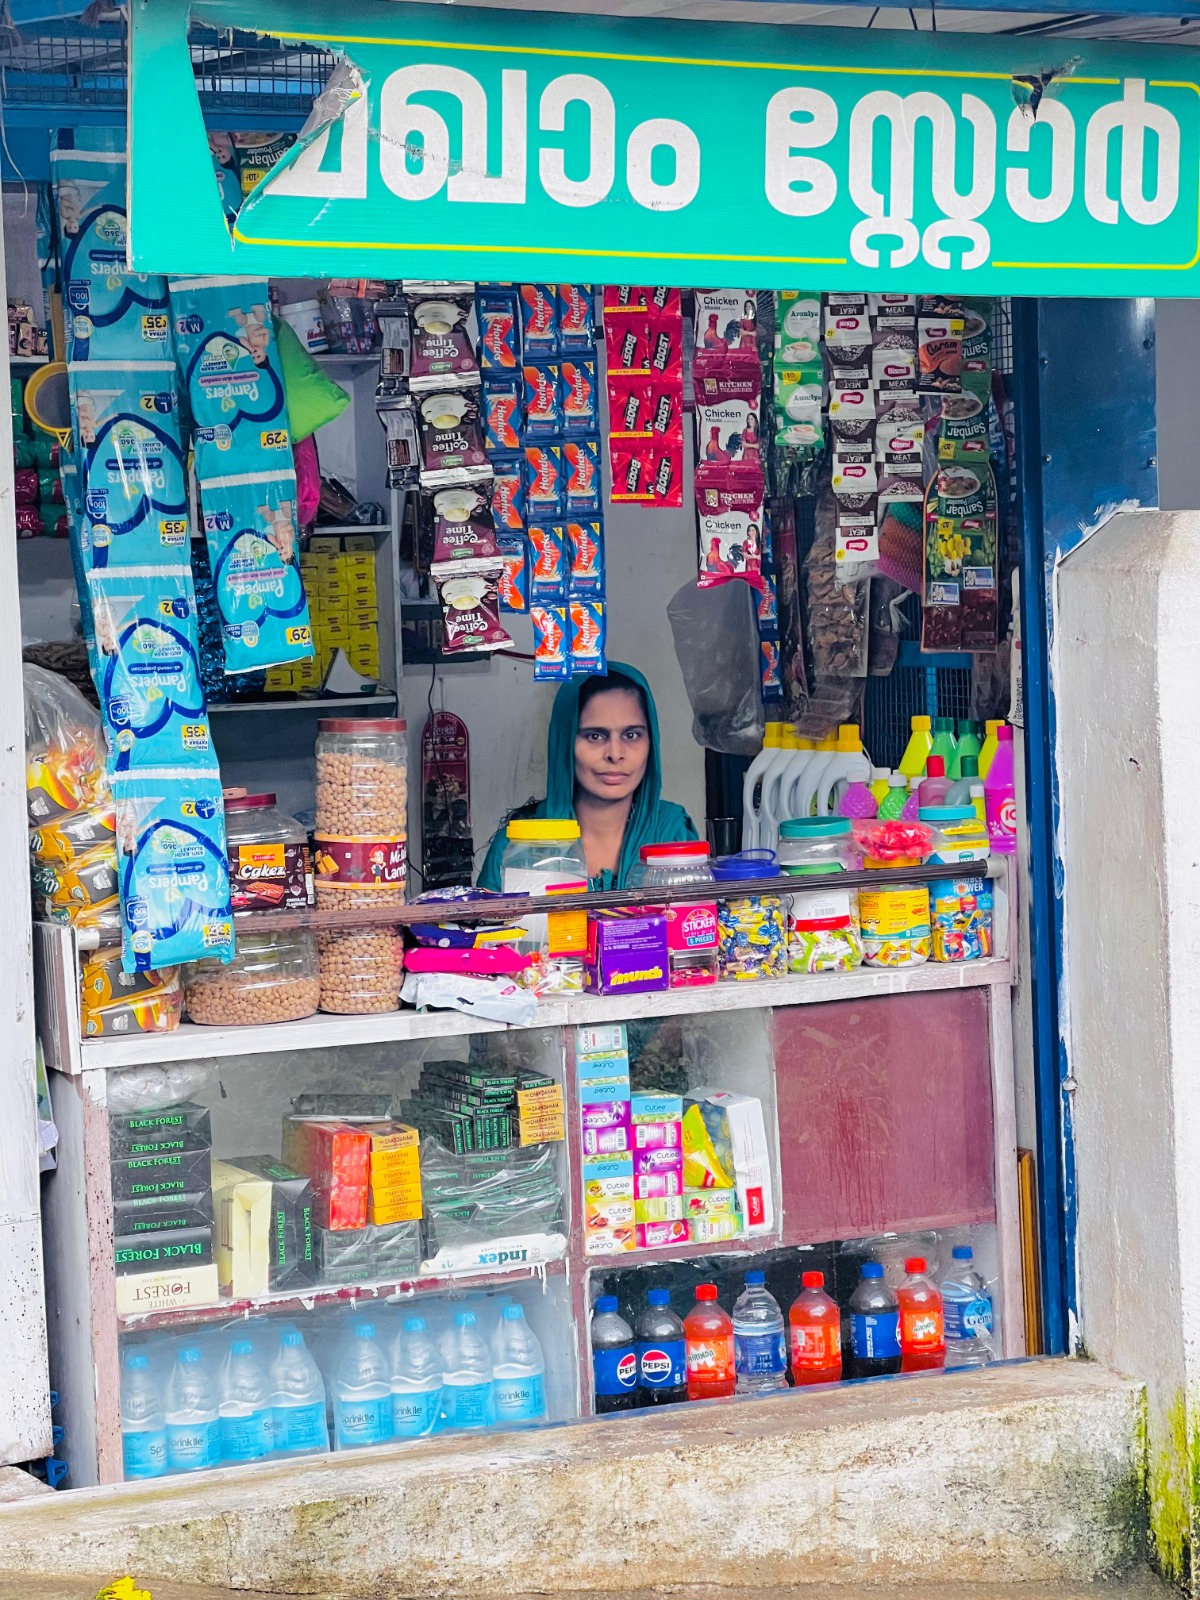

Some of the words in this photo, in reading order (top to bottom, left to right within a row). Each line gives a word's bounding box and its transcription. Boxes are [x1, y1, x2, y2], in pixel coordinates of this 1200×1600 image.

[568, 286, 579, 324] Horlicks
[703, 296, 739, 306] Chicken
[535, 291, 544, 328] Horlicks
[790, 310, 819, 318] Amulya
[840, 307, 857, 315] MEAT
[179, 322, 187, 331] 2
[191, 323, 200, 332] M
[426, 338, 455, 348] Time
[493, 323, 503, 360] Horlicks
[423, 347, 459, 358] Coffee
[623, 333, 637, 367] BOOST
[653, 333, 669, 370] BOOST
[926, 341, 957, 356] Garam
[962, 342, 988, 358] Samb
[206, 383, 259, 401] Pampers
[537, 372, 547, 409] Horlicks
[572, 368, 581, 405] Horlicks
[145, 398, 153, 409] 2
[161, 402, 168, 411] L
[625, 396, 640, 430] BOOST
[655, 396, 671, 432] BOOST
[704, 409, 741, 418] Chicken
[497, 404, 507, 442] Horlicks
[434, 431, 464, 442] Time
[947, 422, 986, 440] Sambar
[432, 440, 468, 451] Coffee
[540, 453, 549, 490] Horlicks
[577, 449, 586, 486] Horlicks
[107, 469, 165, 489] Pampers
[627, 458, 642, 492] BOOST
[656, 458, 671, 495] BOOST
[499, 486, 510, 523] Horlicks
[946, 502, 984, 517] Sambar
[206, 518, 214, 529] 2
[219, 520, 230, 529] M
[446, 525, 474, 535] Time
[849, 528, 866, 536] MEAT
[443, 533, 478, 545] Coffee
[541, 533, 551, 571] Horlicks
[580, 529, 588, 567] Horlicks
[233, 579, 284, 598] Pampers
[163, 603, 171, 613] 2
[178, 608, 185, 617] L
[455, 612, 483, 624] Time
[453, 621, 488, 633] Coffee
[580, 609, 590, 647] Horlicks
[130, 672, 187, 692] Pampers
[186, 804, 194, 815] 2
[241, 863, 286, 879] Cakez
[149, 872, 209, 891] Pampers
[683, 917, 715, 932] STICKER
[610, 966, 663, 986] munch
[594, 1086, 615, 1094] Cutee
[532, 1103, 559, 1111] CHANDANAM
[129, 1118, 154, 1128] BLACK
[155, 1116, 183, 1126] FOREST
[583, 1116, 607, 1124] Cutee
[131, 1143, 159, 1153] FOREST
[160, 1141, 184, 1149] BLACK
[656, 1151, 679, 1159] Cutee
[128, 1160, 152, 1168] BLACK
[153, 1156, 182, 1166] FOREST
[131, 1184, 159, 1194] FOREST
[160, 1181, 184, 1190] BLACK
[606, 1182, 630, 1190] Cutee
[133, 1198, 157, 1206] BLACK
[158, 1194, 187, 1203] FOREST
[707, 1195, 731, 1204] Cutee
[608, 1207, 632, 1215] Cutee
[134, 1221, 161, 1231] FOREST
[162, 1219, 187, 1228] BLACK
[163, 1243, 202, 1257] BLACK
[304, 1233, 312, 1261] FOREST
[589, 1241, 614, 1250] Cutee
[115, 1249, 160, 1263] FOREST
[479, 1249, 527, 1265] Index
[133, 1281, 191, 1301] FOREST
[148, 1299, 177, 1308] WHITE
[913, 1320, 936, 1333] MIRINDA
[967, 1315, 992, 1326] Gems
[643, 1362, 670, 1370] PEPSI
[394, 1406, 422, 1415] prinklle
[171, 1437, 203, 1447] prinklle
